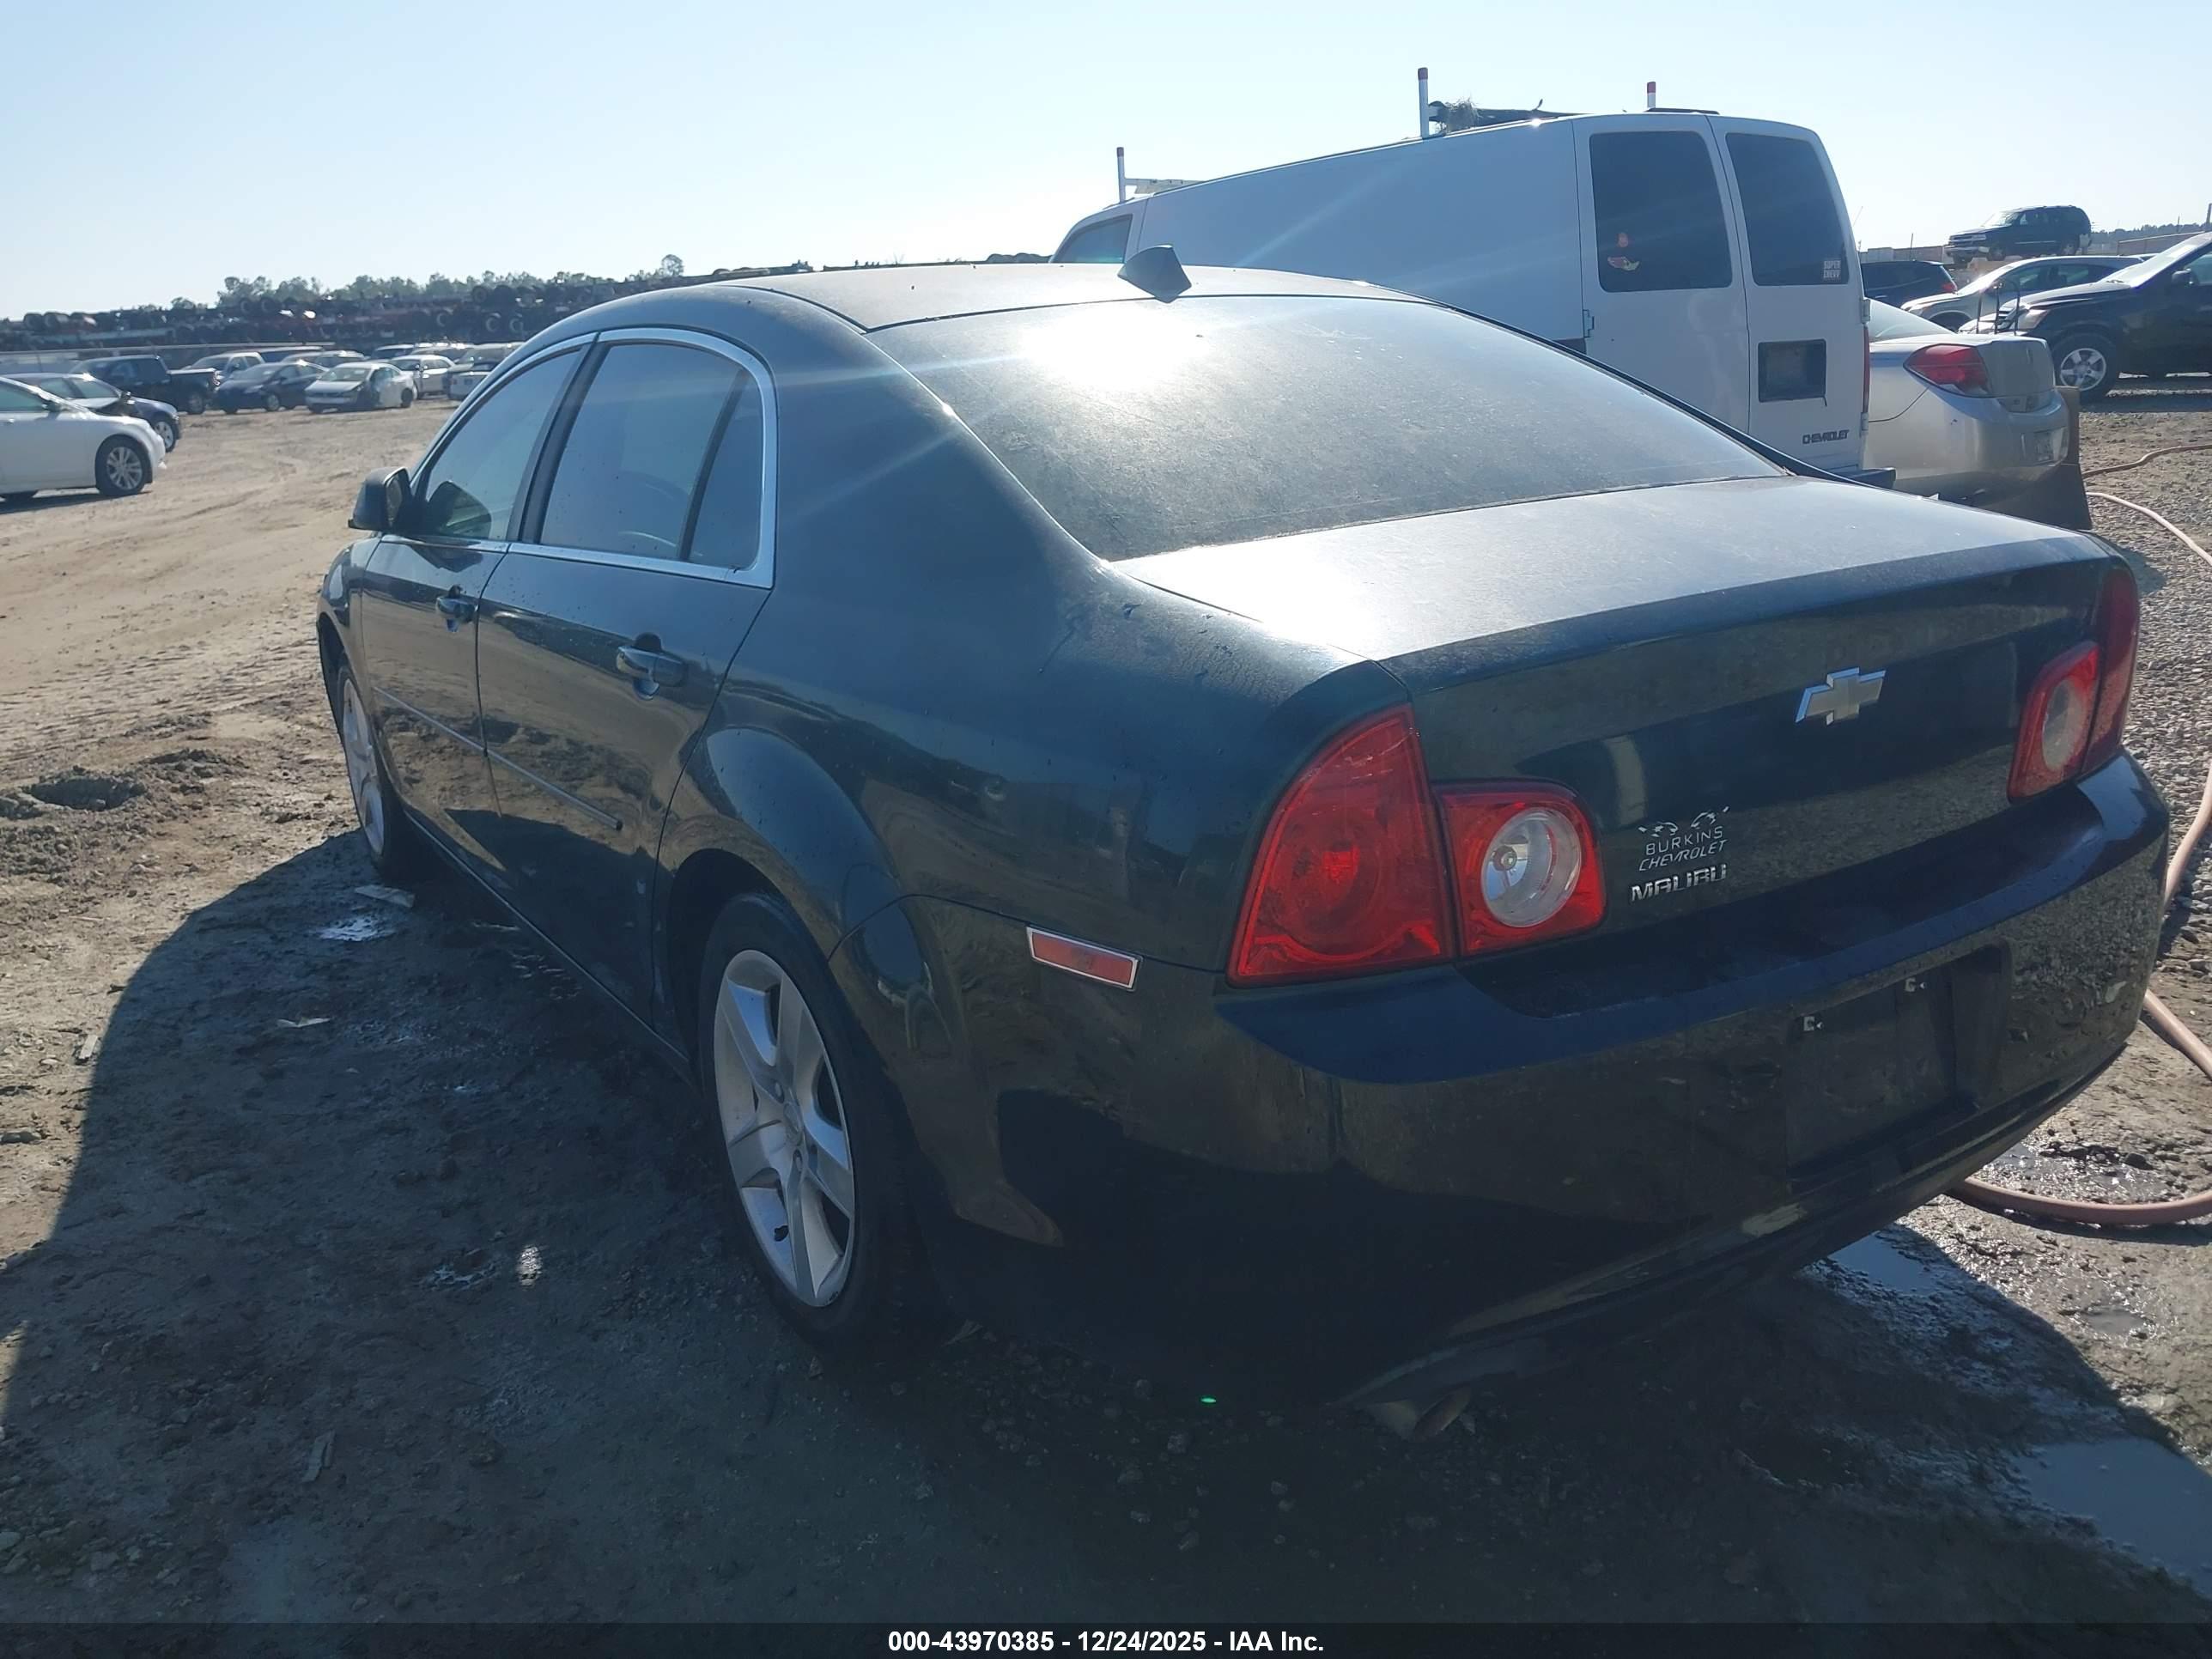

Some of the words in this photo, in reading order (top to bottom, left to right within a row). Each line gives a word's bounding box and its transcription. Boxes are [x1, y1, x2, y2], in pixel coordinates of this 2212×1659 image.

[1802, 429, 1850, 444] CHEVROLET
[1638, 839, 1728, 872] CHEVROLET
[1645, 825, 1723, 856] BURKINS
[1631, 863, 1728, 902] MALIBU
